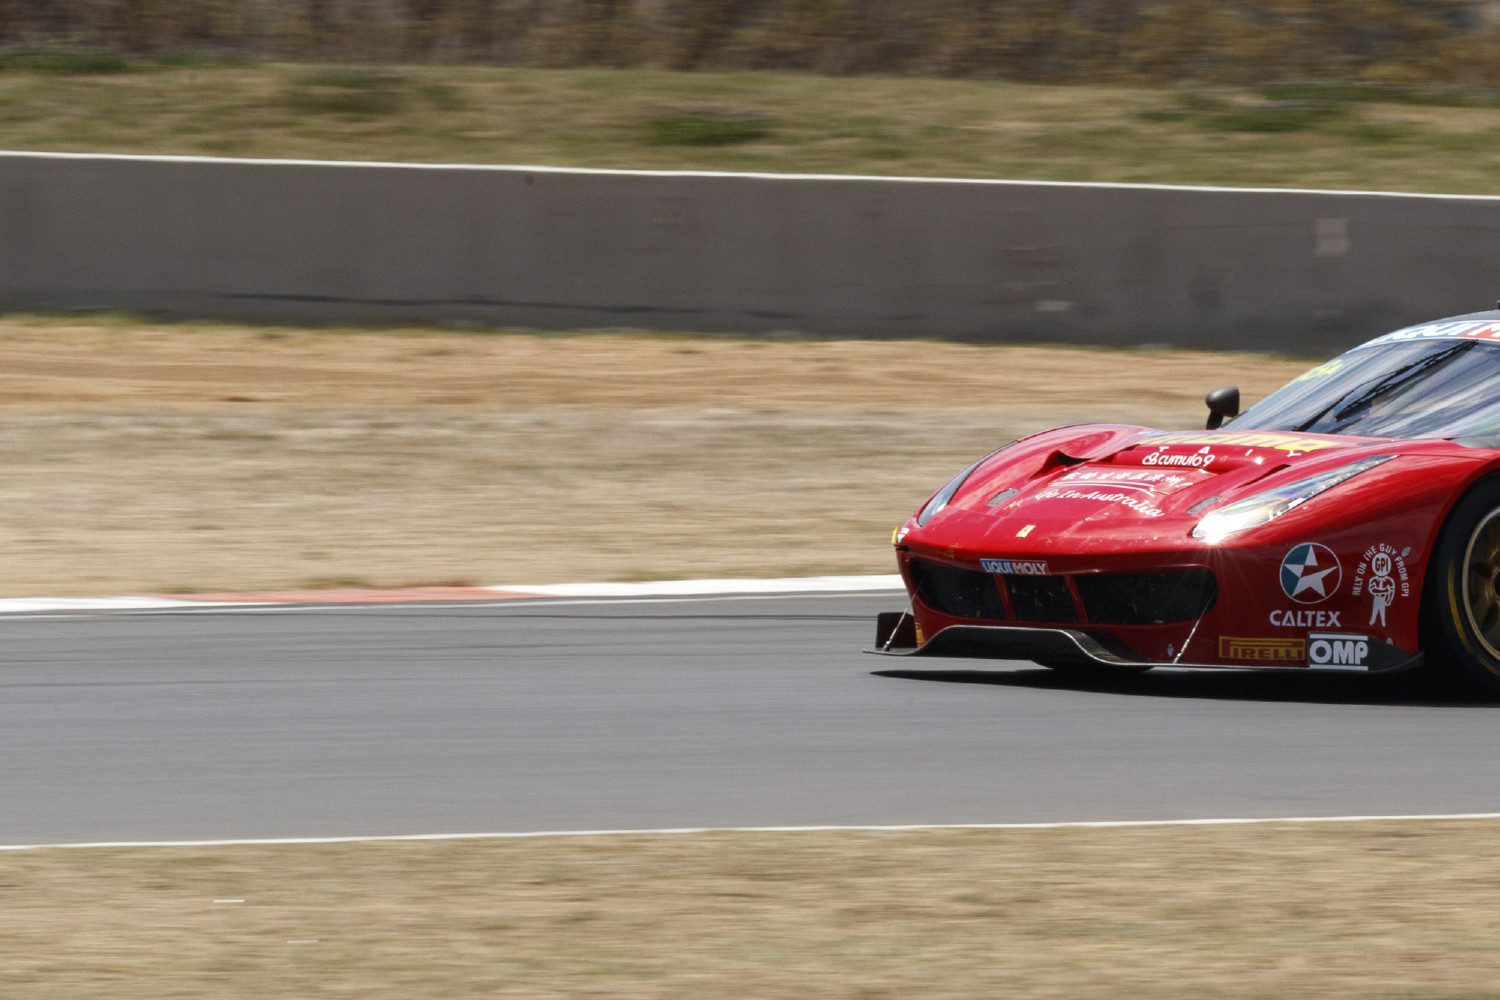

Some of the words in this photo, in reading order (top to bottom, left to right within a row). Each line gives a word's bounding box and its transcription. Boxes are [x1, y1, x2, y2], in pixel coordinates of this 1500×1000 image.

[1379, 543, 1398, 555] GUY
[981, 561, 1012, 574] LIQUI
[1013, 562, 1047, 575] MOLY
[1356, 562, 1368, 575] ON
[1375, 558, 1389, 572] GPI
[1394, 556, 1409, 580] FROM
[1352, 576, 1363, 596] RELY
[1401, 582, 1410, 597] GPI
[1269, 610, 1341, 627] CALTEX
[1220, 638, 1305, 660] PIRELLI
[1309, 639, 1369, 665] OMP
